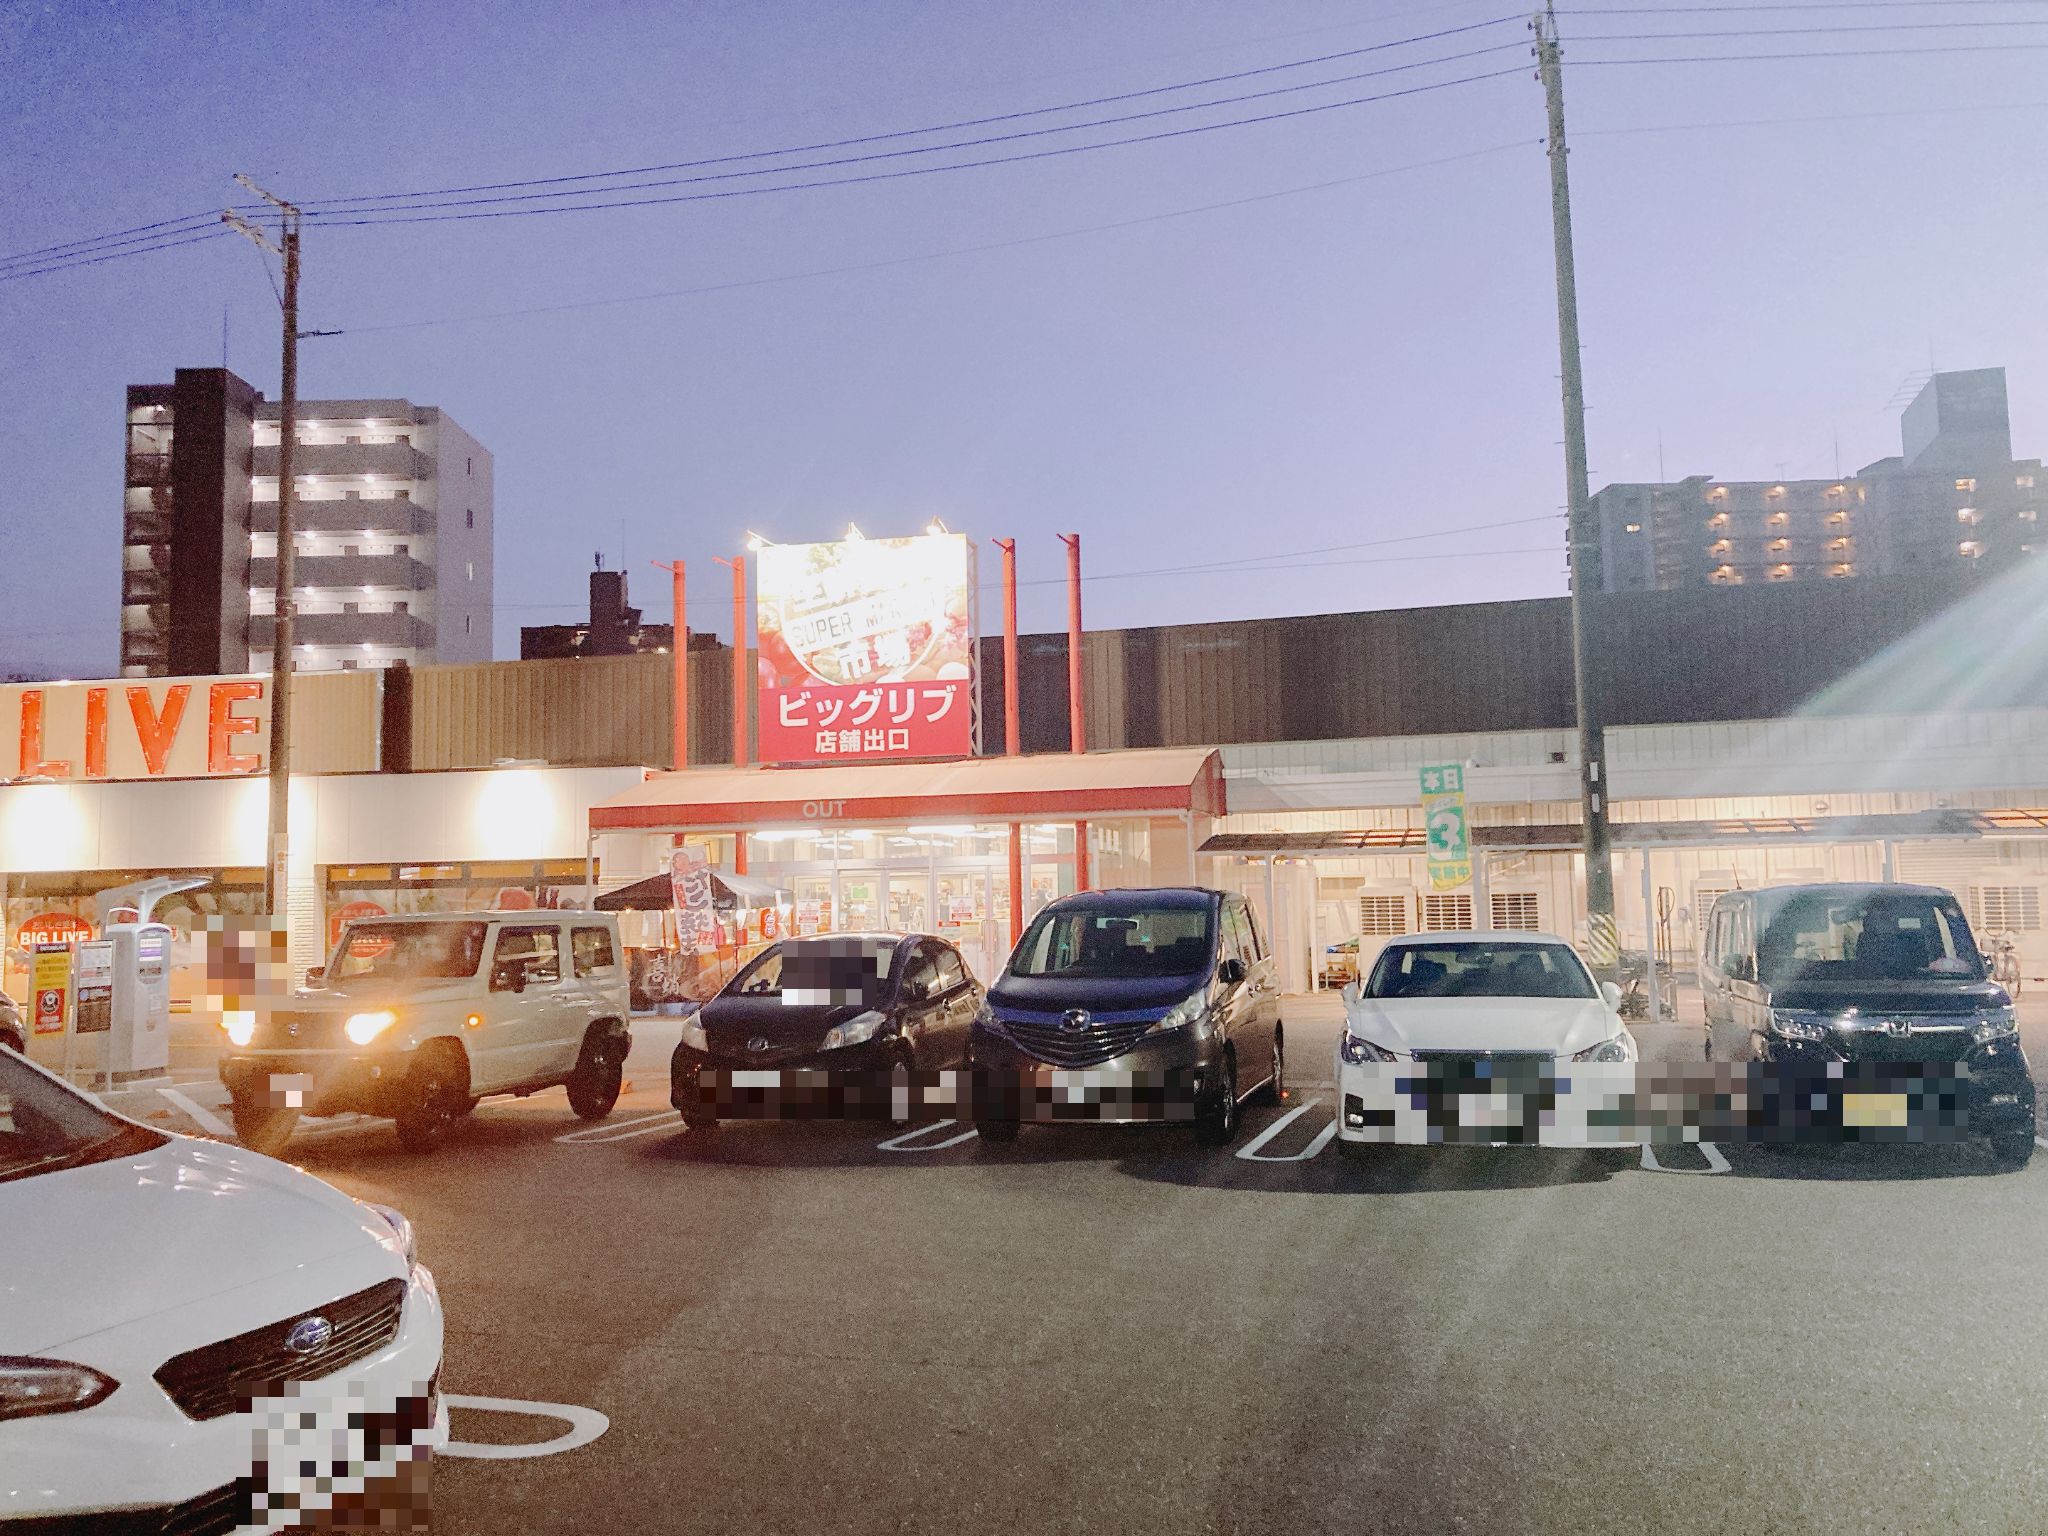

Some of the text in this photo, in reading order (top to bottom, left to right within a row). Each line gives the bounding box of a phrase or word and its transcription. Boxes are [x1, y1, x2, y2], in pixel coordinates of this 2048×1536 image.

[790, 611, 854, 648] SUPER
[779, 684, 957, 727] ビッグリブ
[18, 682, 264, 777] LIVE
[815, 728, 909, 754] 店舗出口
[1423, 767, 1460, 791] 本日
[803, 801, 846, 818] OUT
[20, 930, 89, 946] BIG LIVE
